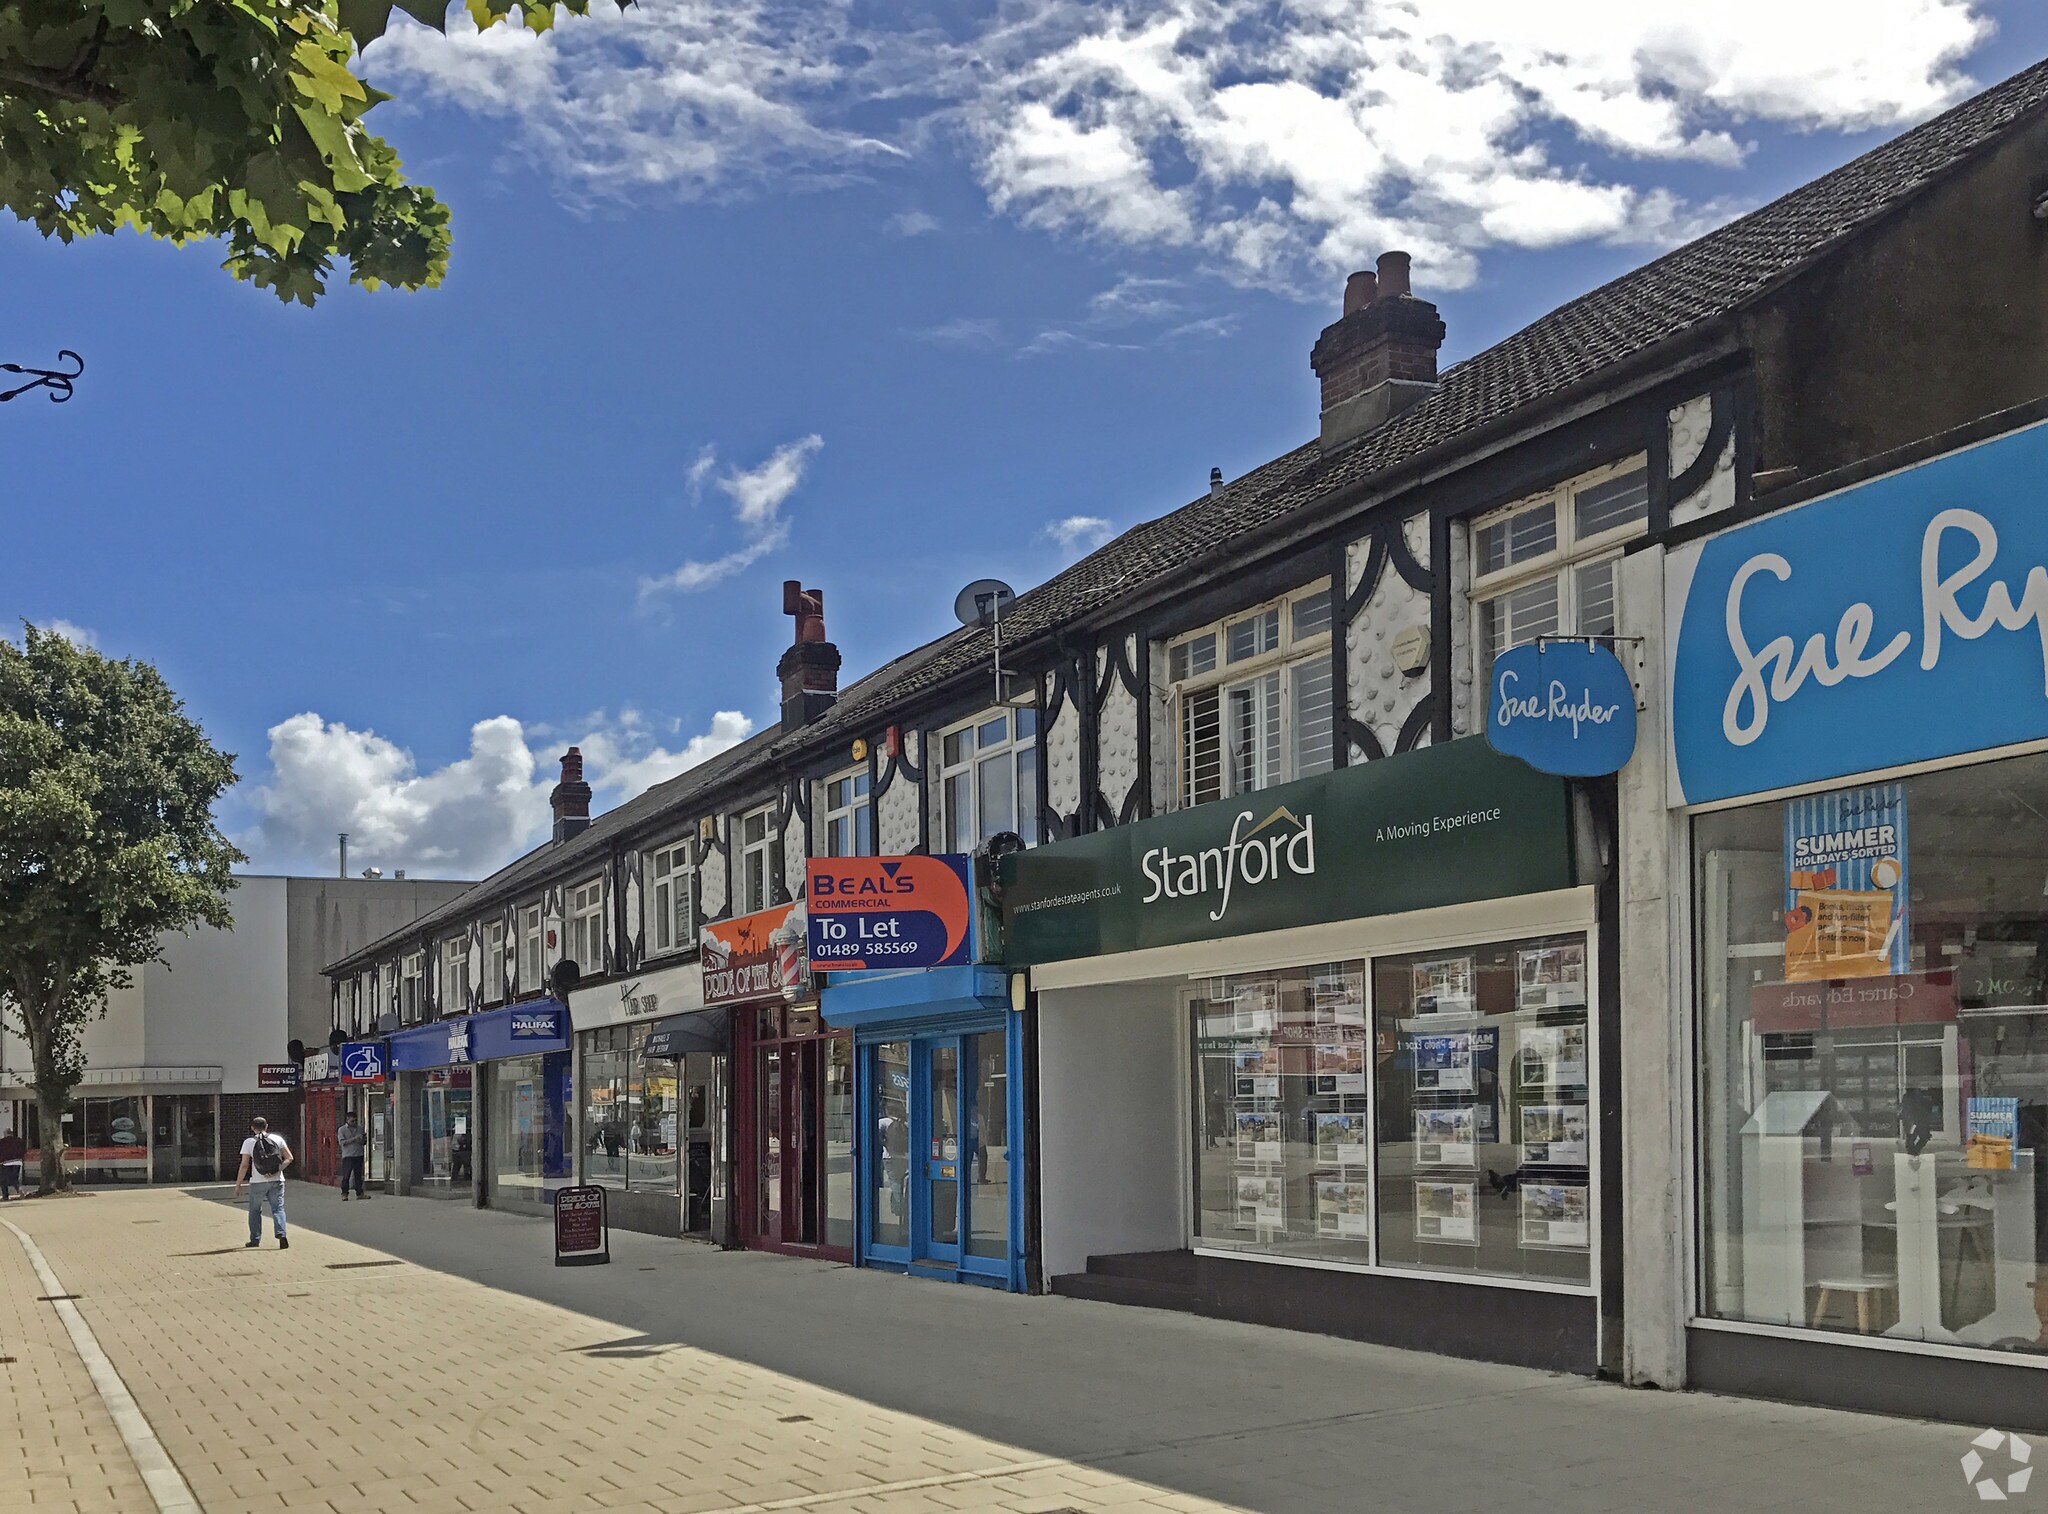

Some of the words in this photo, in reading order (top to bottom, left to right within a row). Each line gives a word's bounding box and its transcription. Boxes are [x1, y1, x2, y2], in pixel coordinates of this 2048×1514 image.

[1722, 552, 1911, 747] Sue
[1497, 670, 1547, 726] Sue
[1548, 679, 1619, 739] Ryder
[1375, 827, 1384, 842] A
[1386, 820, 1430, 840] Moving
[1433, 806, 1501, 833] Experience
[1795, 825, 1895, 857] SUMMER
[1142, 810, 1315, 921] Stanford
[1795, 850, 1849, 867] HOLIDAYS
[1850, 844, 1897, 860] SORTED
[813, 874, 915, 896] BEALS
[815, 898, 891, 909] COMMERCIAL
[1012, 883, 1122, 914] www.stanfordestateagents.co.uk
[815, 918, 847, 940] To
[858, 917, 901, 939] Let
[816, 943, 860, 957] 01489
[865, 941, 918, 955] 585569
[704, 968, 735, 999] PRIDE
[736, 966, 751, 994] OF
[640, 993, 658, 1013] SHOP
[512, 1020, 555, 1029] HALIFAX
[1970, 1112, 2013, 1120] SUMMER
[560, 1194, 586, 1203] PRIDE
[587, 1193, 600, 1201] OF
[574, 1201, 600, 1210] SOUTH
